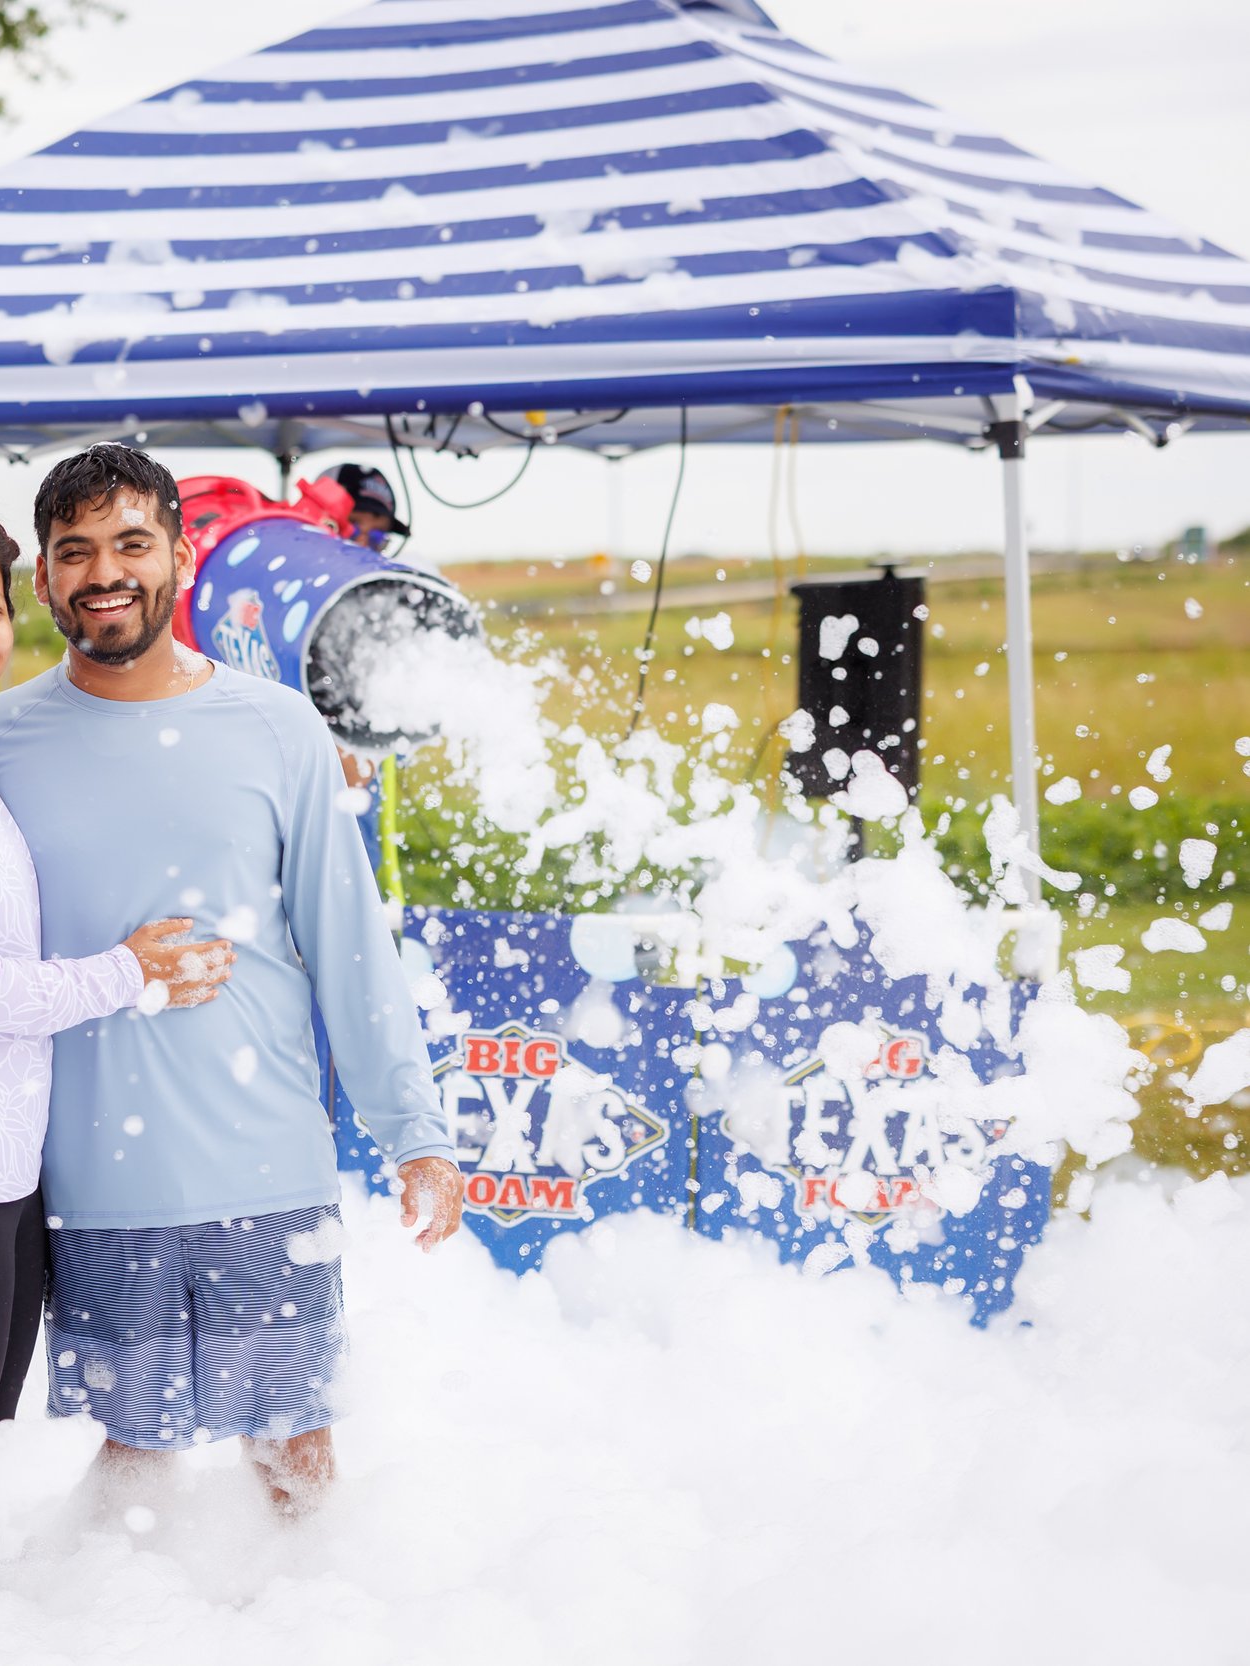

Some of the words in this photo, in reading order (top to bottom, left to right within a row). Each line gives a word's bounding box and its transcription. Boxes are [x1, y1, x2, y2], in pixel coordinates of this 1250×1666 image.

[465, 1038, 559, 1078] BIG
[438, 1074, 627, 1175] EXS
[463, 1175, 575, 1210] OAM
